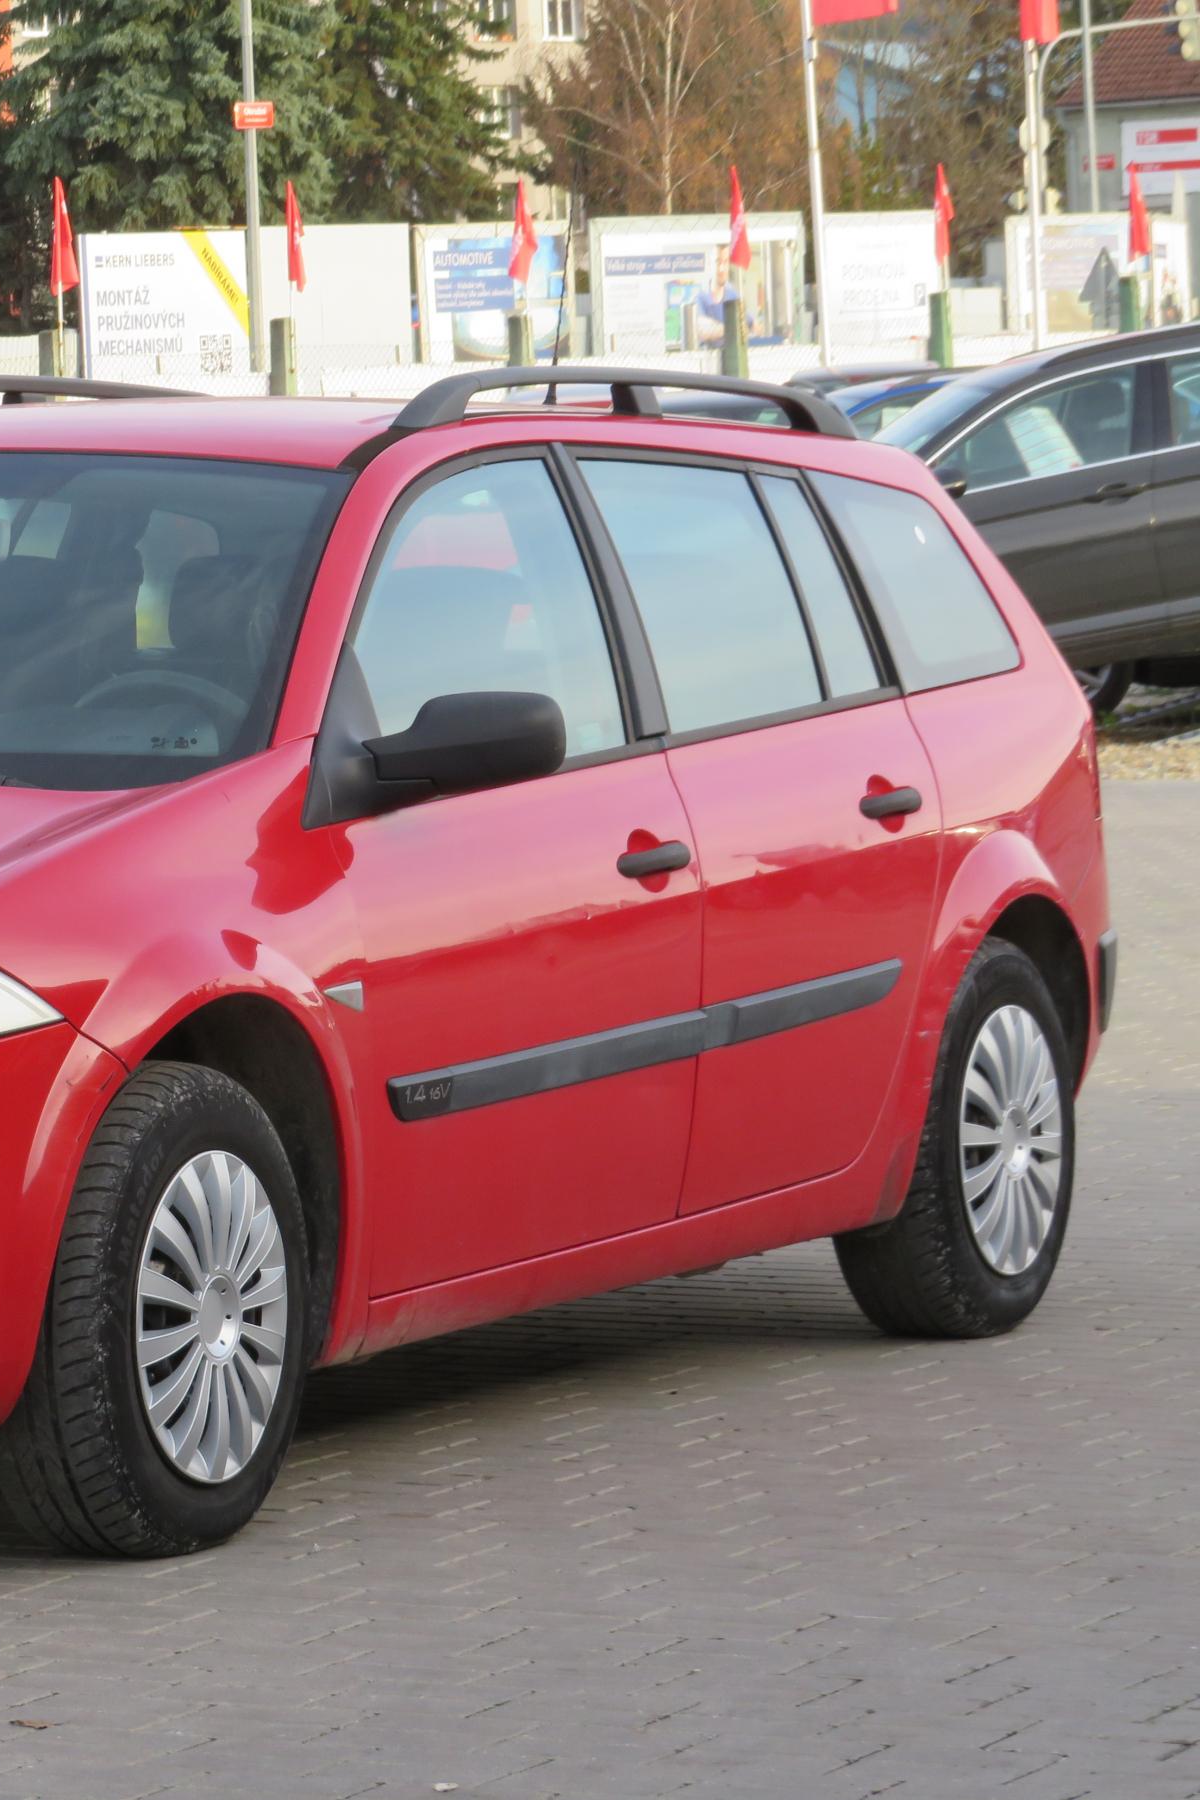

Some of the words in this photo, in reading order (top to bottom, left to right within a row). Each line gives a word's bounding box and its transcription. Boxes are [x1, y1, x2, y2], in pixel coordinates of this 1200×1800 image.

[105, 254, 131, 268] KERN
[134, 253, 175, 267] LIEBERS
[434, 251, 495, 267] AUTOMOTIVE
[96, 285, 150, 307] MONTÁŽ
[97, 310, 186, 331] PRUŽINOVÝCH
[405, 1084, 426, 1104] 1.4
[429, 1082, 451, 1100] 16V
